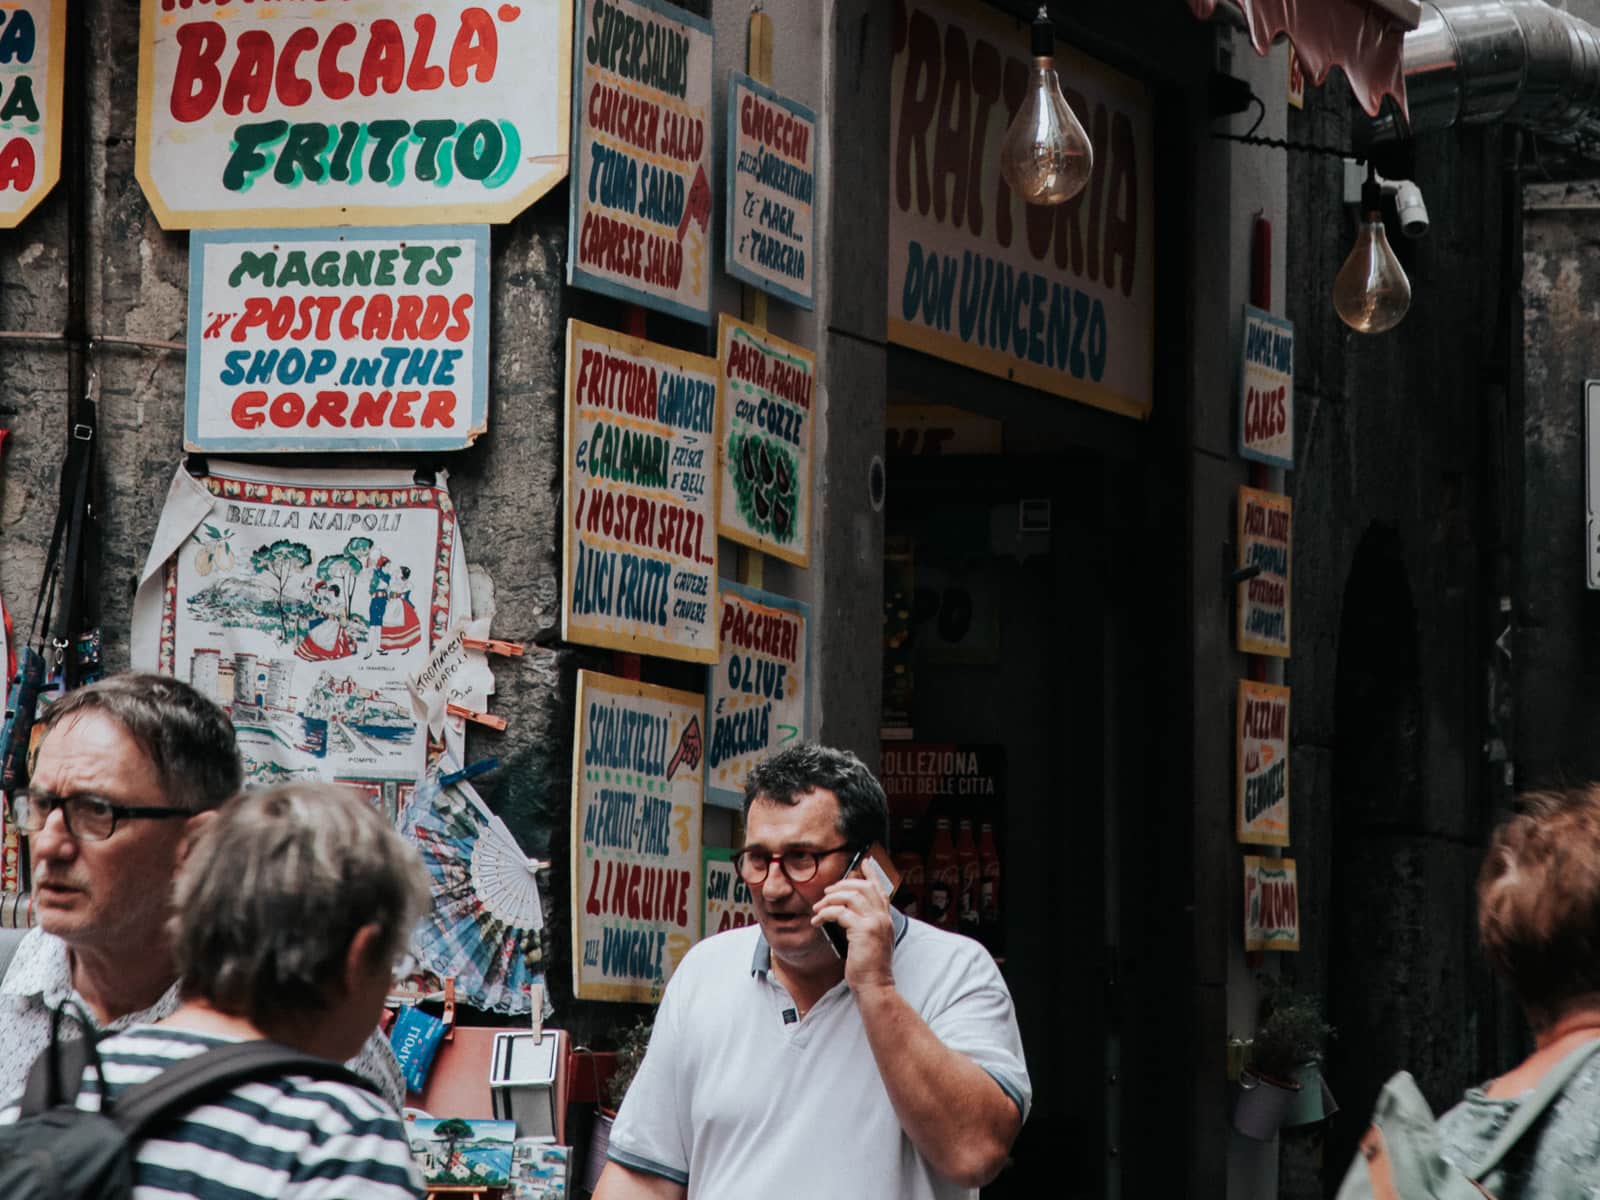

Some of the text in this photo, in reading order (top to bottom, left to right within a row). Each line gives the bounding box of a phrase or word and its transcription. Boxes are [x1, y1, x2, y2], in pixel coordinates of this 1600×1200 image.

[222, 118, 514, 191] FRITTO
[589, 82, 704, 162] CHICKEN SALAD
[741, 95, 809, 164] GNOCCHI
[588, 141, 684, 227] TUNA SALAD
[228, 245, 461, 288] MAGNETS
[580, 211, 684, 290] CAPRESE SALAD
[230, 294, 474, 342] POSTCARDS
[902, 240, 1106, 383] DON VINCENZO
[220, 347, 337, 385] SHOP
[380, 346, 463, 387] THE
[576, 348, 716, 434] FRITTURA GAMBERI
[727, 340, 766, 388] PASTA
[771, 359, 812, 409] FAGIOLI
[736, 397, 802, 446] CON COZZE
[1244, 385, 1286, 444] CAKES
[589, 422, 670, 490] CALAMARI
[225, 503, 402, 534] BELLA NAPOLI
[575, 488, 586, 531] I
[587, 488, 656, 548] NOSTRI
[573, 540, 671, 627] ALICI FRITTE
[719, 603, 798, 663] PACCHERI
[728, 654, 786, 700] OLIVE
[585, 702, 668, 777] SCIALATIELLI
[916, 777, 954, 794] DELLE
[596, 788, 636, 849] FRUTTI
[637, 795, 672, 856] MARE
[586, 860, 691, 927] LINGUINE
[708, 870, 731, 900] SAN
[601, 927, 666, 980] VONGOLE
